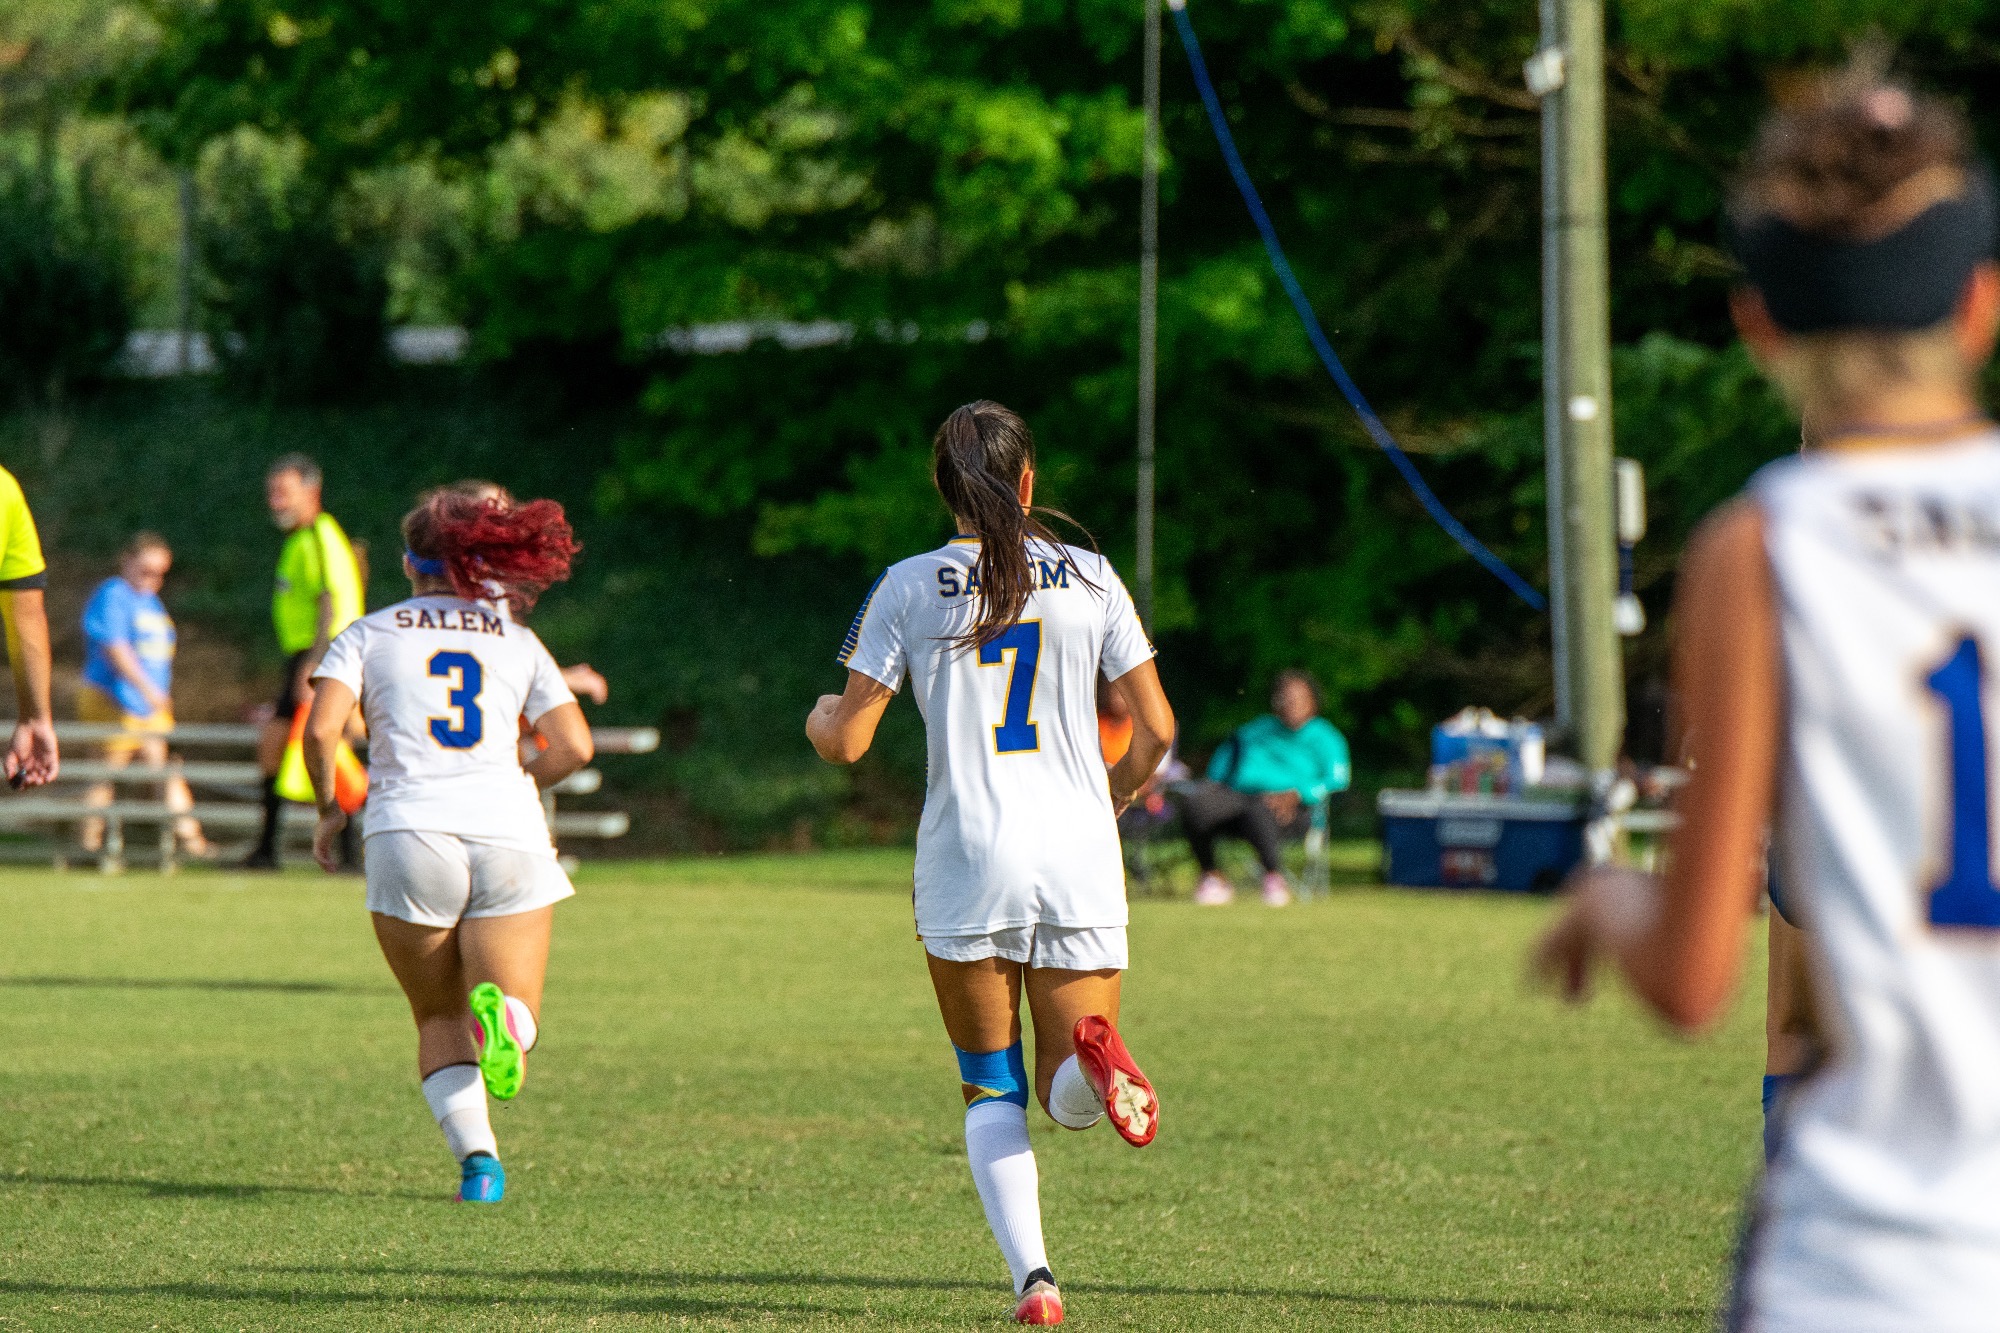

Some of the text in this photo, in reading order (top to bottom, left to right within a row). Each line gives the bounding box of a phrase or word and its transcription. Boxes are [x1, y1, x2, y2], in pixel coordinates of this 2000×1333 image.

[937, 558, 1070, 598] SAM
[395, 608, 505, 638] SALEM
[426, 648, 483, 752] 3
[976, 617, 1043, 755] 7
